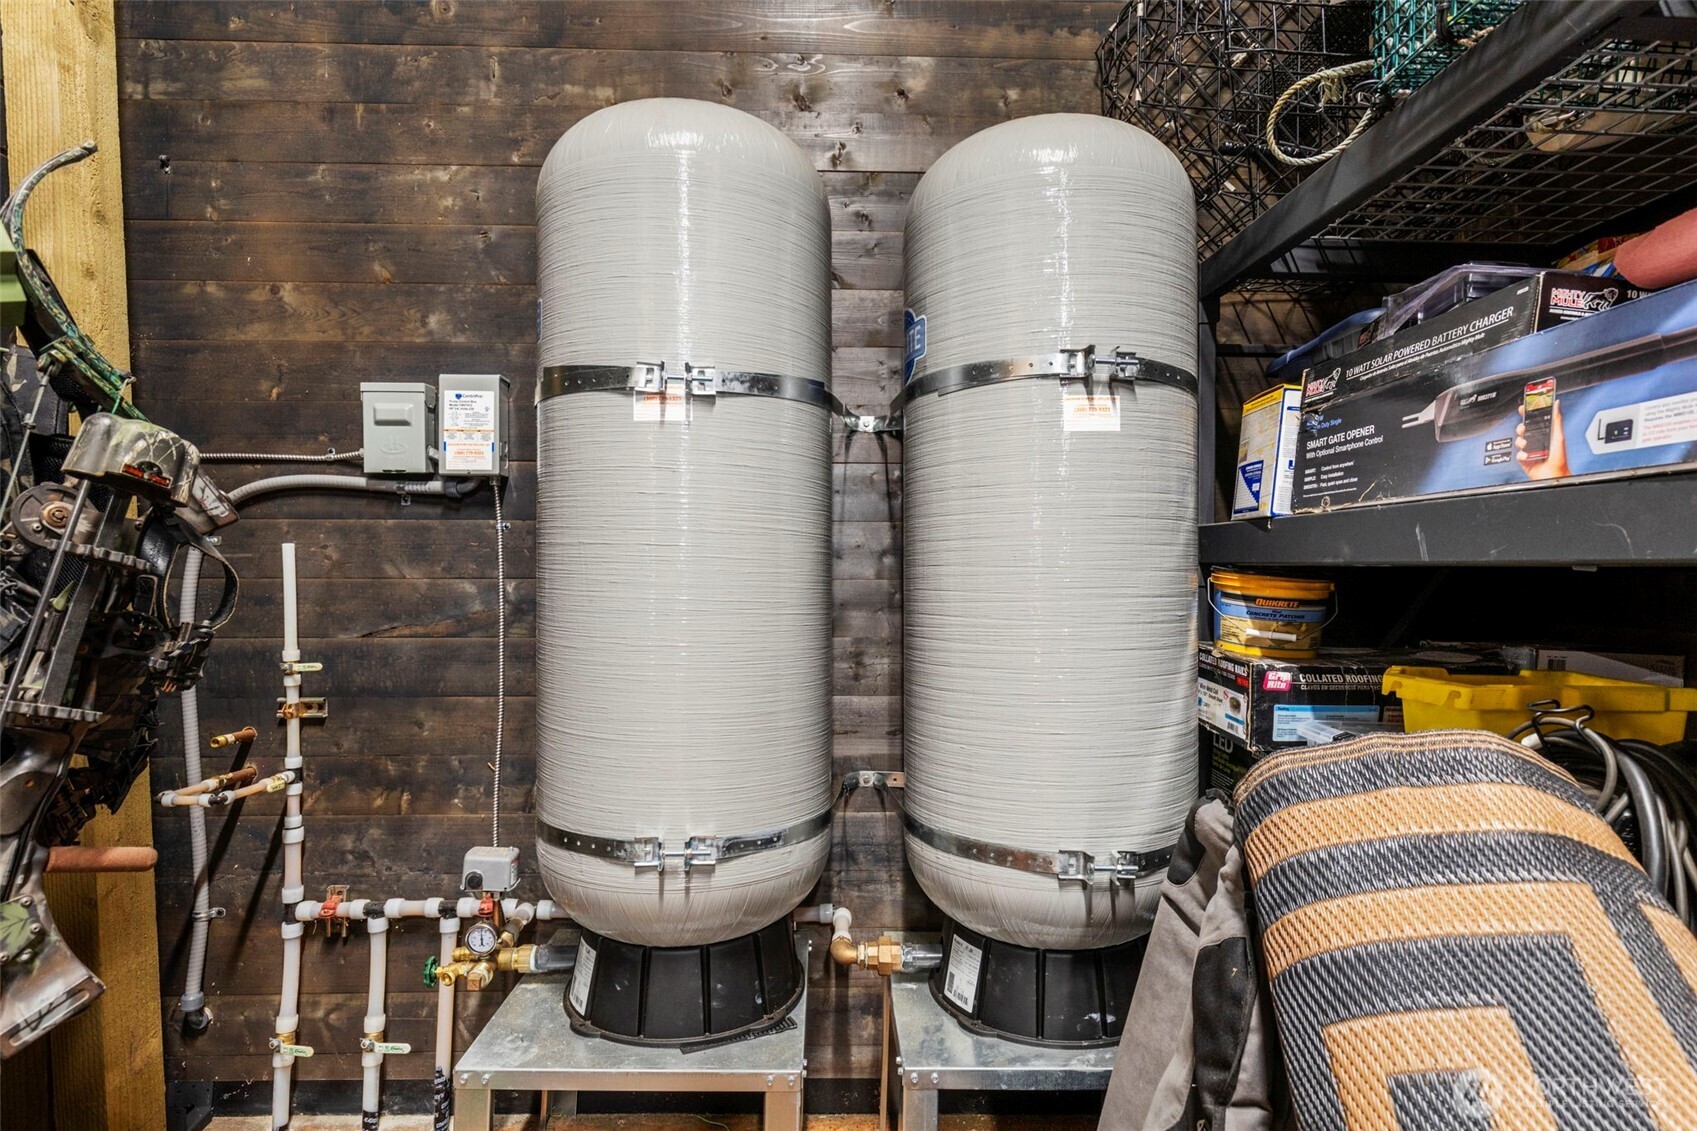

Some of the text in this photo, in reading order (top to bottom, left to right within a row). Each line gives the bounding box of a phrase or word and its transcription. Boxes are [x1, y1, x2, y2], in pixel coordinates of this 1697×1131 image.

[1552, 288, 1586, 299] MIGHTY
[1627, 289, 1637, 299] 10
[1551, 296, 1584, 308] MULE
[1346, 306, 1514, 378] 10 WATT SOLAR POWERED BATTERY CHARGER
[1306, 425, 1375, 450] SMART GATE OPENER
[1316, 447, 1335, 458] Optional
[1335, 440, 1364, 453] Smartphone
[1364, 435, 1384, 447] Control
[1255, 598, 1299, 608] QUIKRETE
[1246, 609, 1278, 619] CONCRETE
[1267, 671, 1292, 681] Grip
[1299, 673, 1344, 683] COLLATED
[1267, 680, 1287, 689] Rite
